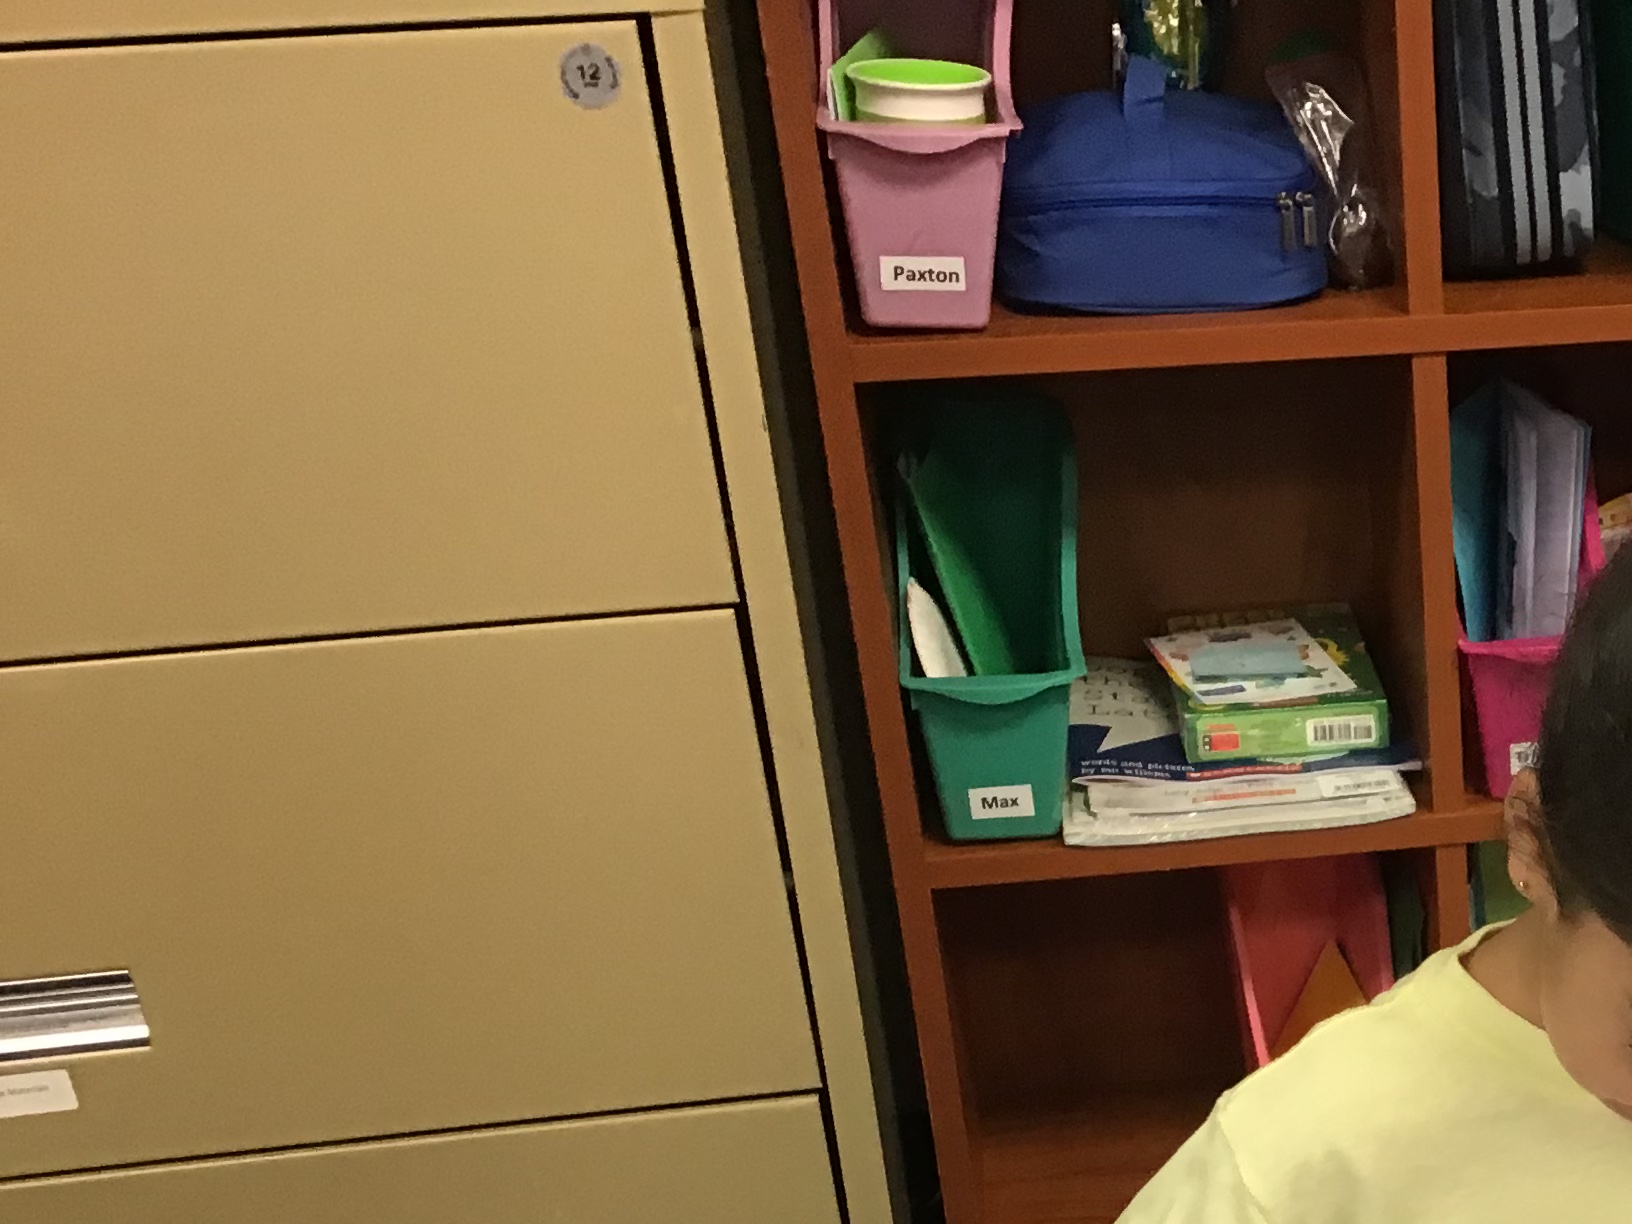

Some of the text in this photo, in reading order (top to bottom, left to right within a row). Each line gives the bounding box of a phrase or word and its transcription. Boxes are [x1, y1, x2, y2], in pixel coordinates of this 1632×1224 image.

[576, 62, 602, 81] 12
[893, 265, 960, 283] Paxton
[980, 795, 1020, 810] Max
